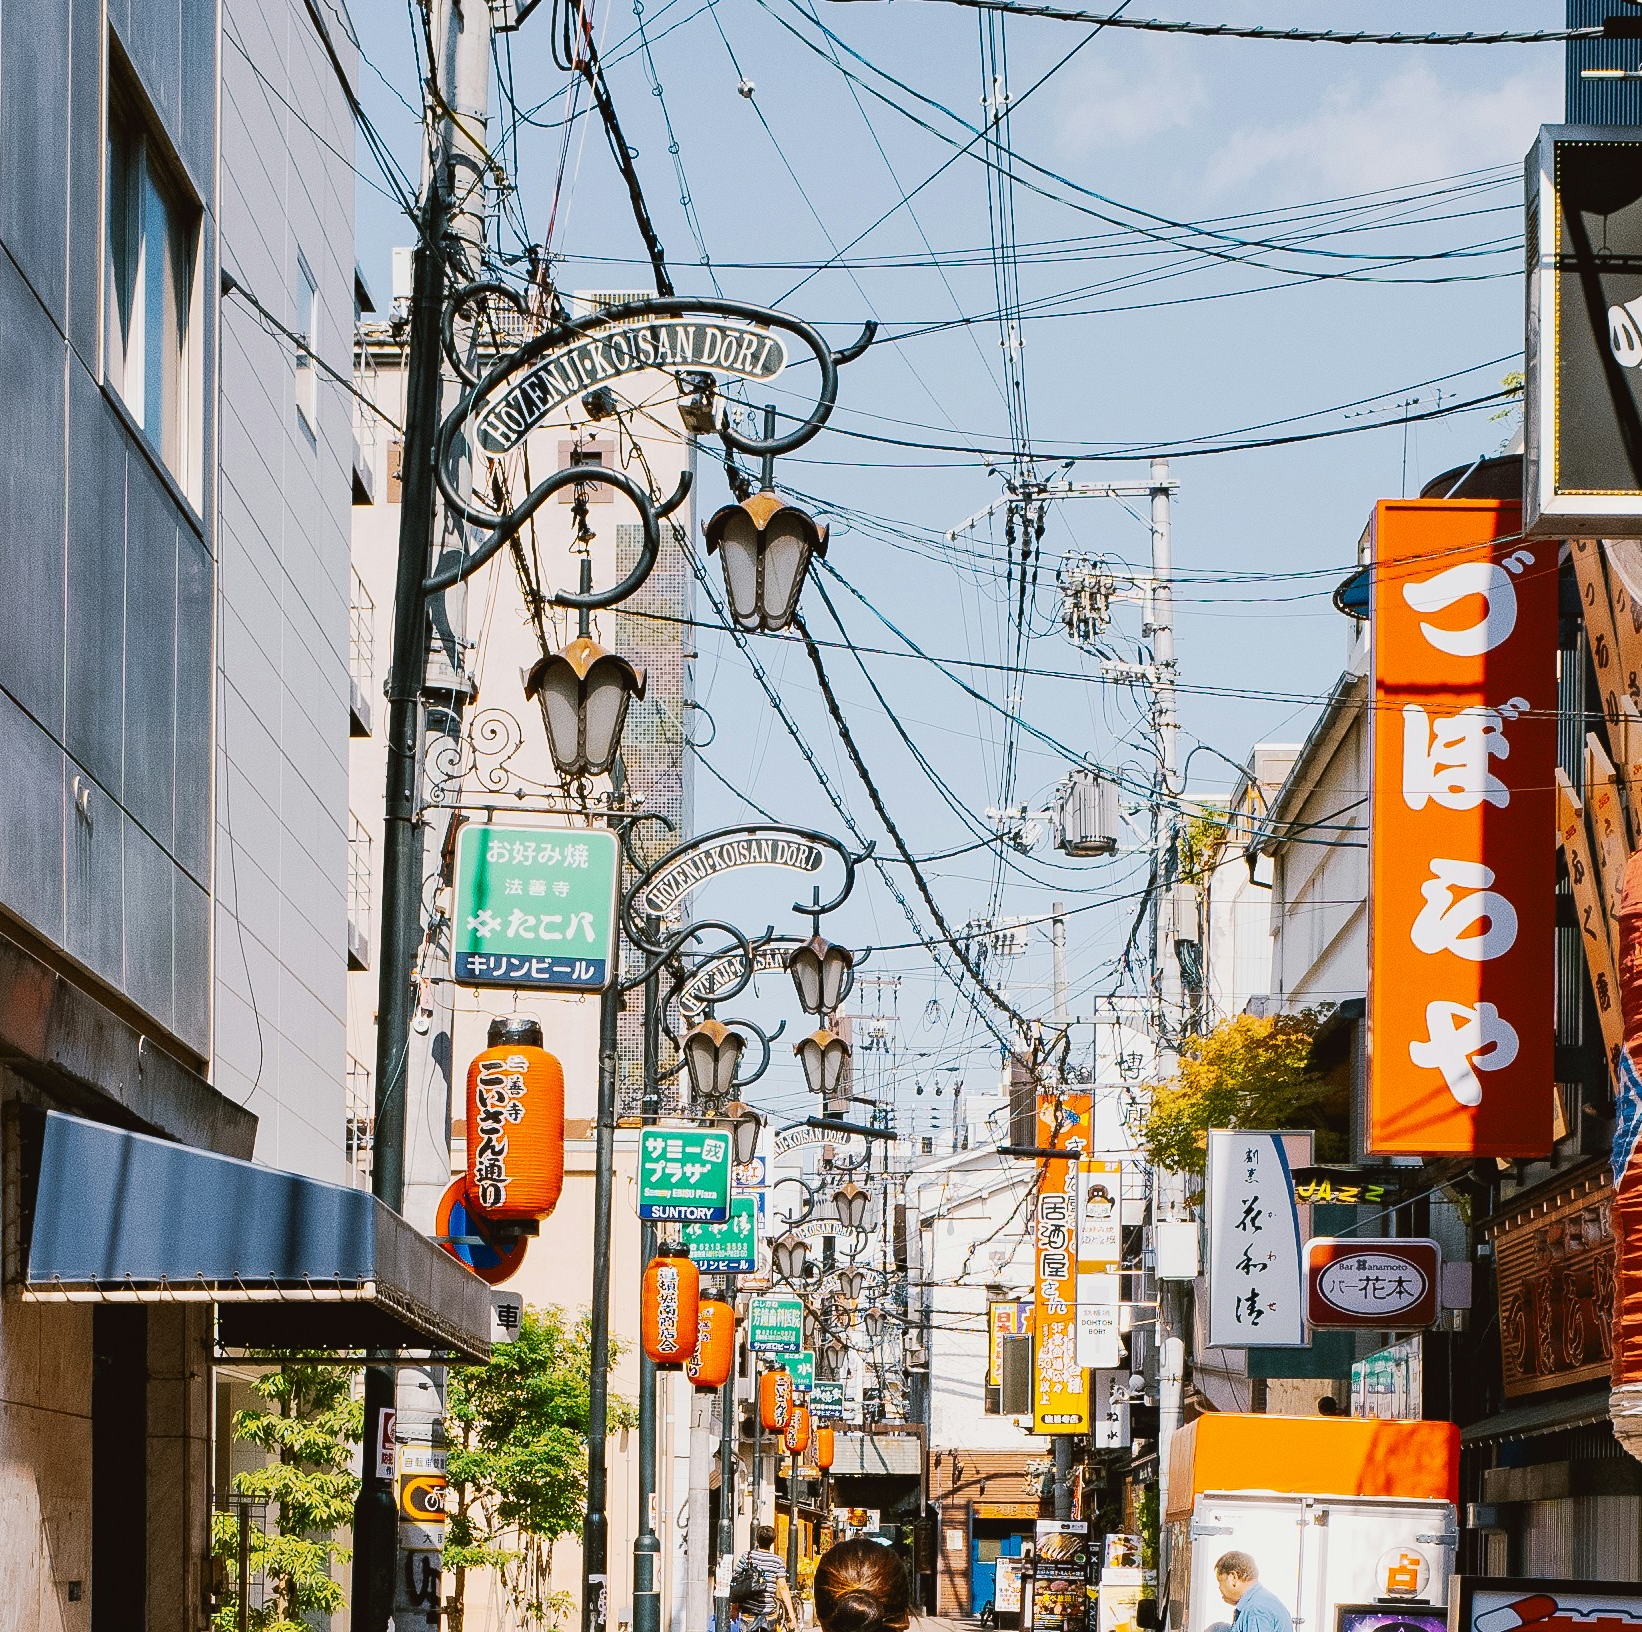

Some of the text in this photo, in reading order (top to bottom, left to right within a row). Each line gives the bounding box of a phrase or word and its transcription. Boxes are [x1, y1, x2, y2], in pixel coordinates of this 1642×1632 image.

[1403, 549, 1535, 1107] づぼらや
[486, 840, 589, 869] お好み焼
[505, 879, 570, 898] 法善寺
[466, 955, 596, 981] キリンビール
[475, 1060, 510, 1210] こいさん通り
[644, 1160, 712, 1184] プラザ
[652, 1206, 714, 1219] SUNTORY
[1339, 1263, 1353, 1271] Bar
[1330, 1276, 1414, 1300] バー花本
